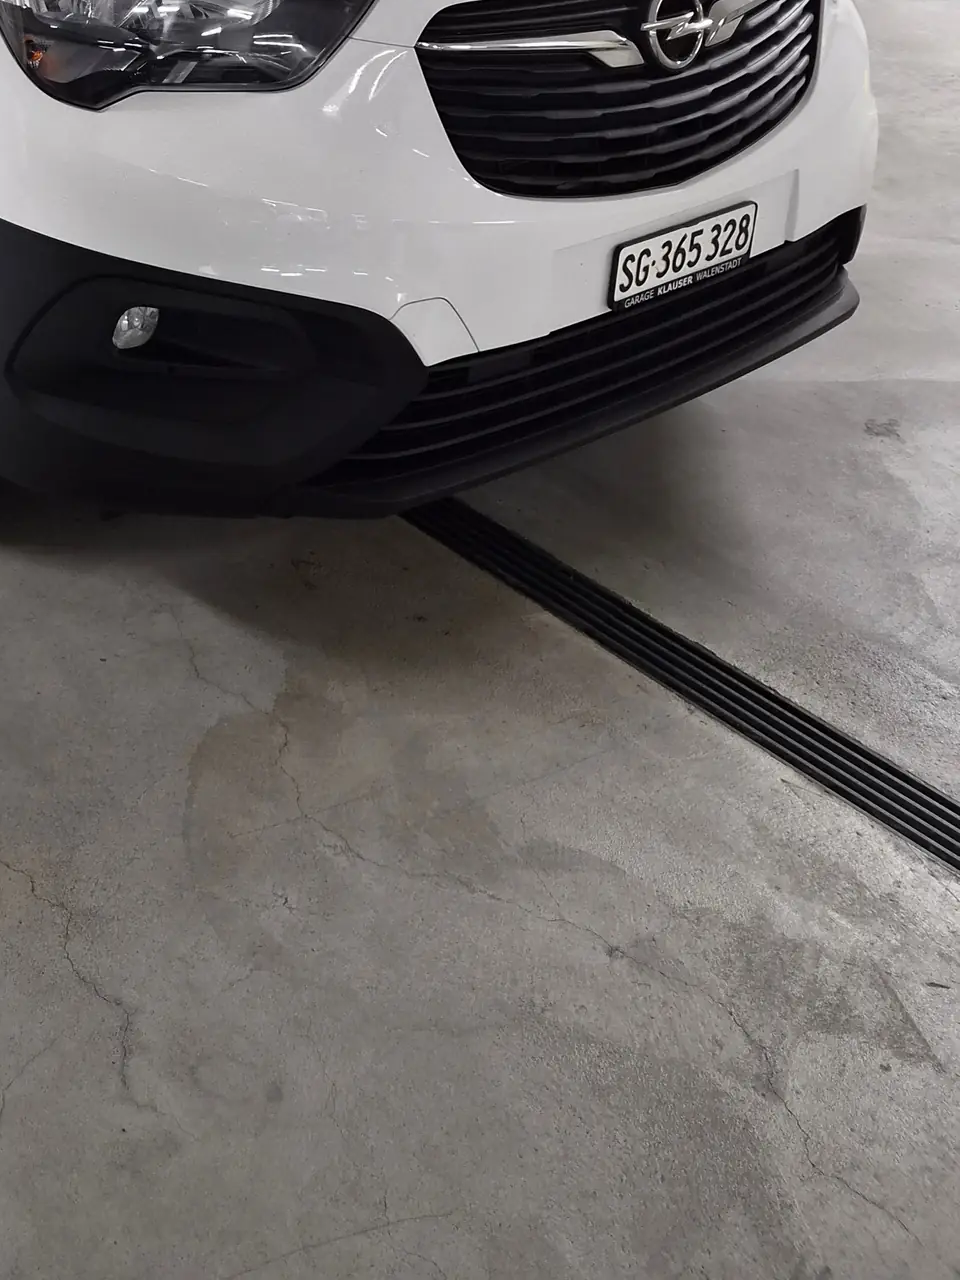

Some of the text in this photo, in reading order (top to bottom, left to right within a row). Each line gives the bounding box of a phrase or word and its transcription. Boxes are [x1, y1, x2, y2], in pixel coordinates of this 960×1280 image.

[705, 214, 751, 261] 328
[624, 257, 743, 308] GARAGE KLAUSER WALENSTADT
